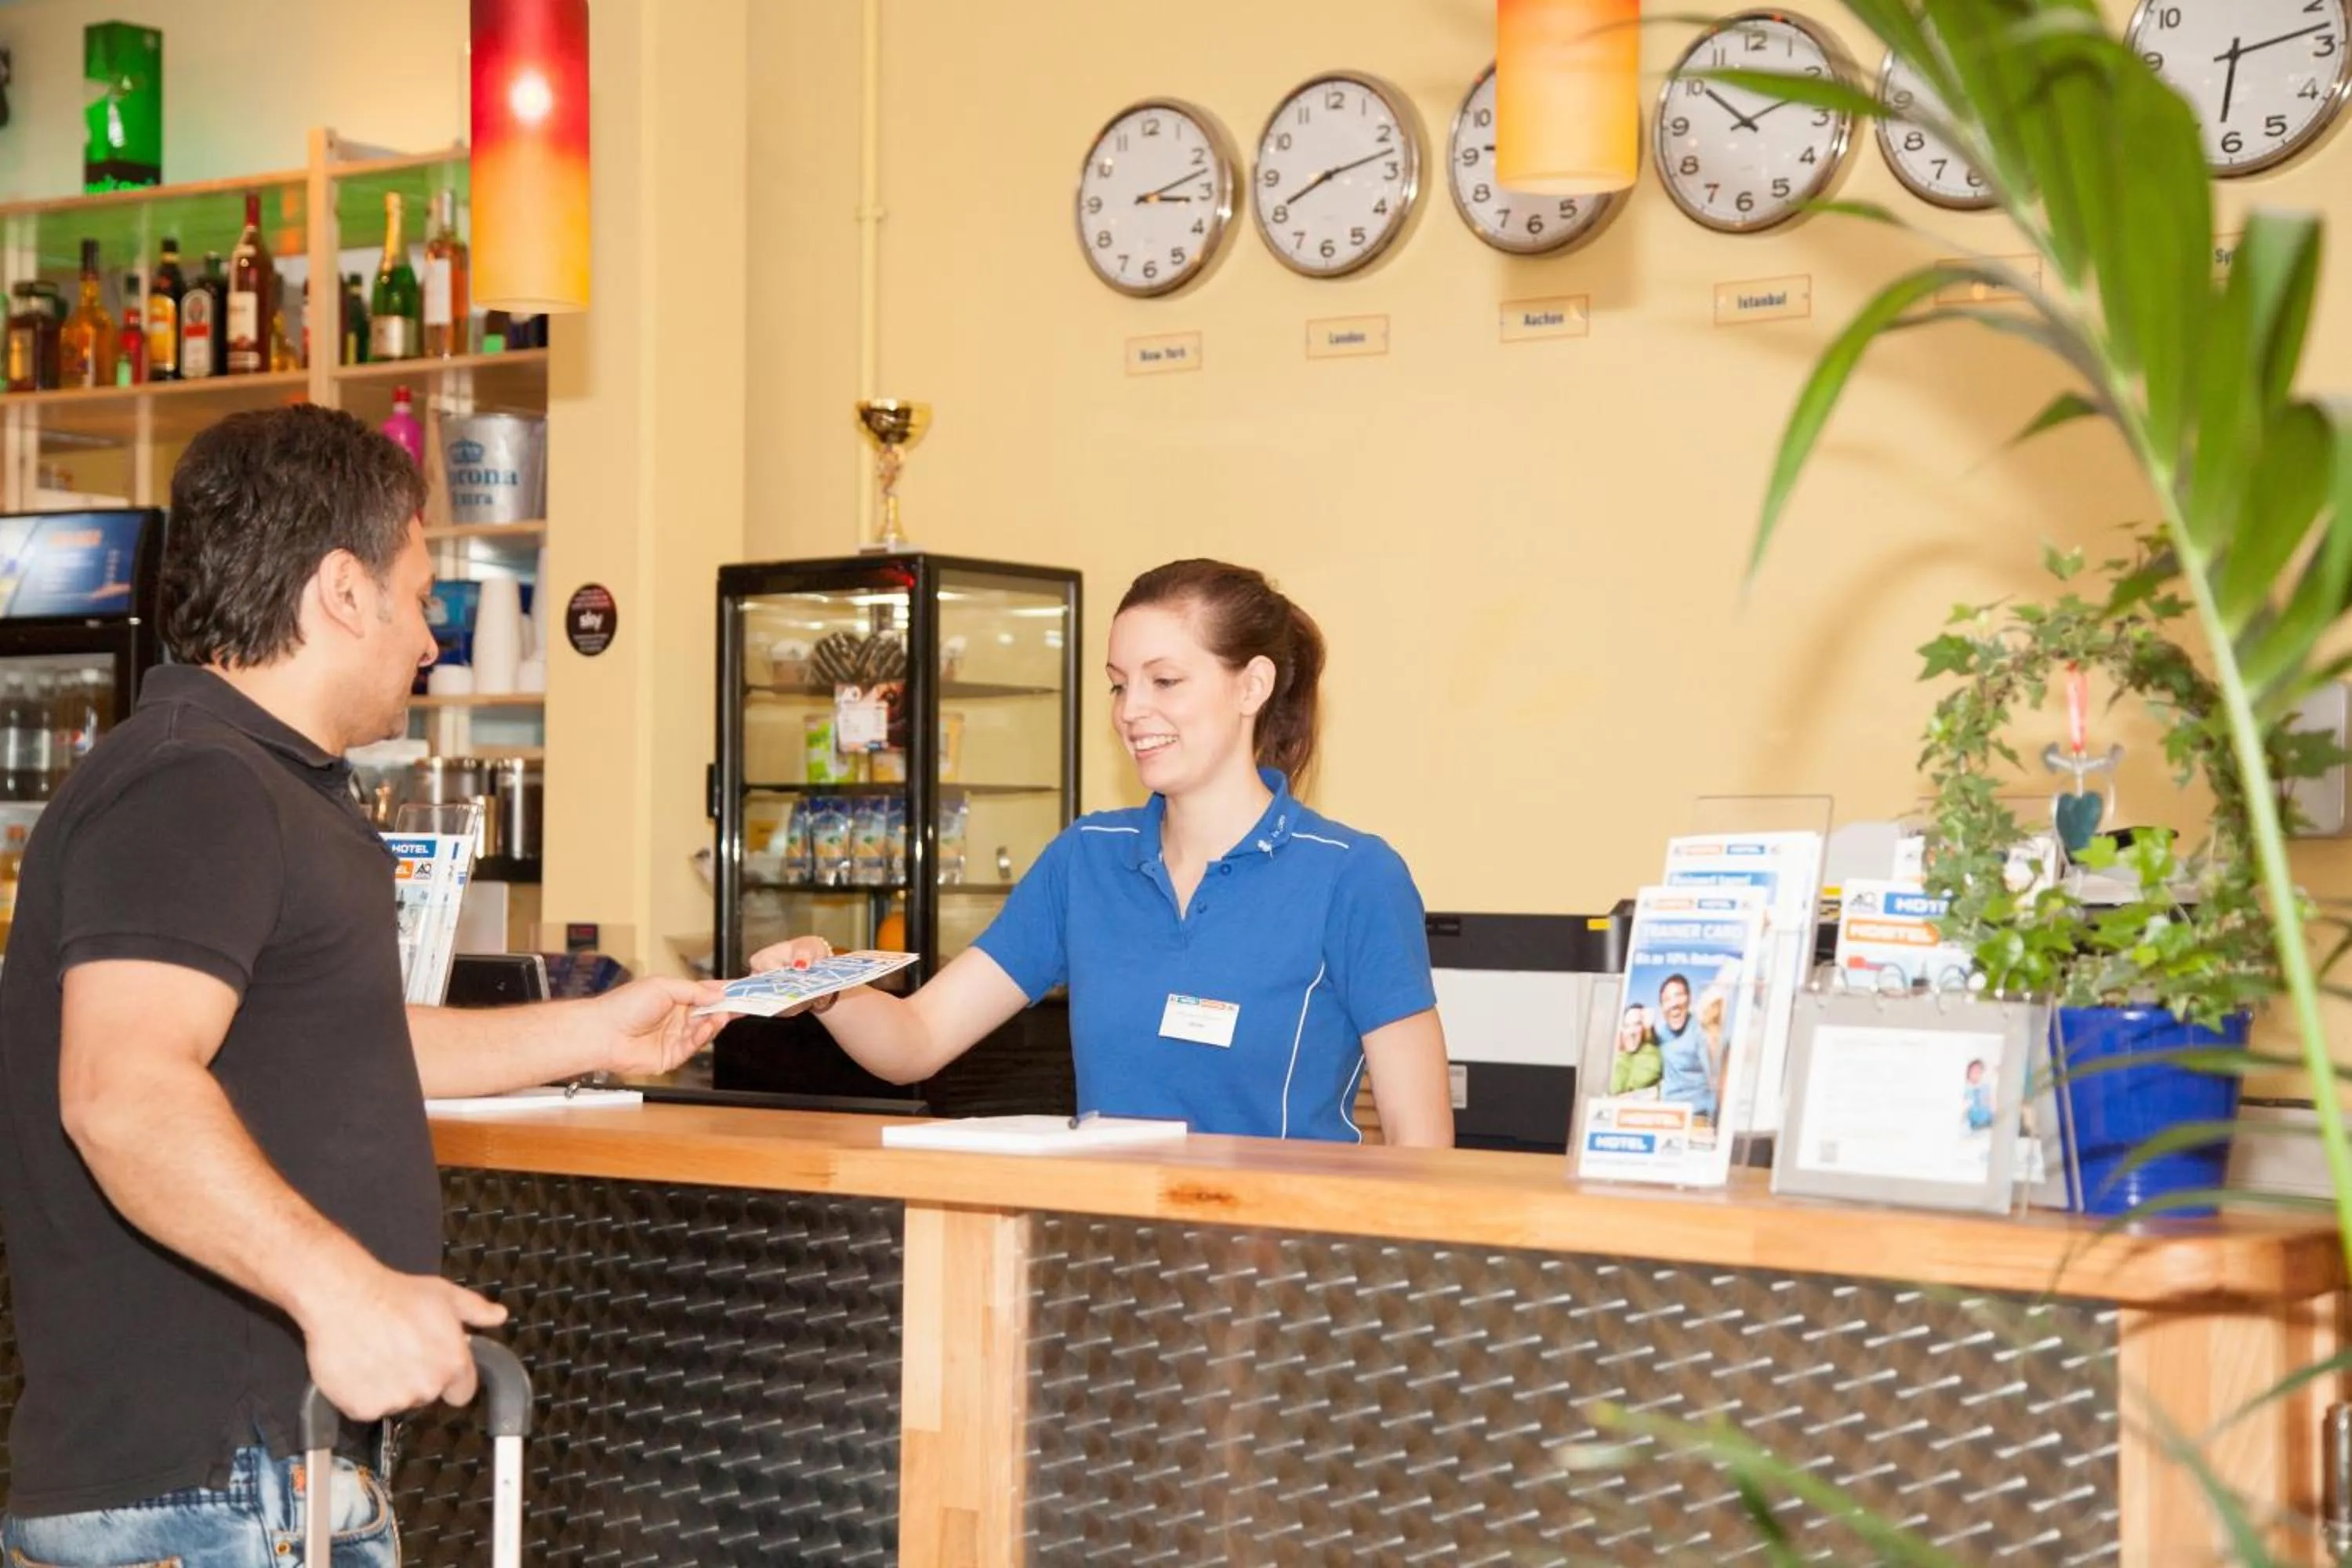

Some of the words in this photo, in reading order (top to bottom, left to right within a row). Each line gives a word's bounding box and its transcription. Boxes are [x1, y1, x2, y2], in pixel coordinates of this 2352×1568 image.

[2160, 8, 2180, 29] 10
[1744, 30, 1768, 51] 12
[2314, 34, 2335, 57] 3
[1711, 47, 1726, 66] 11
[2143, 53, 2163, 72] 9
[1686, 78, 1704, 96] 10
[2297, 78, 2319, 100] 4
[1326, 91, 1345, 110] 12
[1298, 107, 1309, 124] 11
[1474, 108, 1491, 127] 10
[1811, 107, 1830, 126] 3
[1142, 118, 1160, 136] 12
[1377, 125, 1391, 143] 2
[1671, 118, 1690, 136] 9
[2265, 115, 2287, 136] 5
[1116, 134, 1128, 151] 11
[1276, 133, 1291, 151] 10
[1904, 132, 1925, 151] 8
[2221, 132, 2242, 154] 6
[1192, 148, 1205, 165] 2
[1462, 148, 1479, 166] 9
[1799, 147, 1816, 164] 4
[1384, 162, 1399, 180] 3
[1679, 156, 1699, 175] 8
[1931, 159, 1947, 180] 7
[1265, 170, 1279, 187] 9
[1772, 178, 1790, 198] 5
[1199, 182, 1213, 201] 3
[1472, 184, 1490, 203] 8
[1704, 183, 1719, 203] 7
[1087, 197, 1102, 214] 9
[1373, 198, 1387, 215] 4
[1560, 199, 1577, 219] 5
[1736, 191, 1754, 212] 6
[1272, 205, 1288, 223] 8
[1497, 209, 1512, 228] 7
[1192, 219, 1204, 234] 4
[1526, 215, 1544, 234] 6
[1097, 230, 1112, 249] 8
[1293, 231, 1305, 249] 7
[1351, 227, 1366, 245] 5
[1171, 248, 1185, 265] 5
[1320, 240, 1335, 258] 6
[1117, 254, 1129, 273] 7
[1143, 261, 1157, 278] 6
[1737, 292, 1787, 310] Istanbul
[579, 609, 604, 632] sky
[391, 843, 430, 854] HOTEL
[1595, 1135, 1648, 1149] HOTEL
